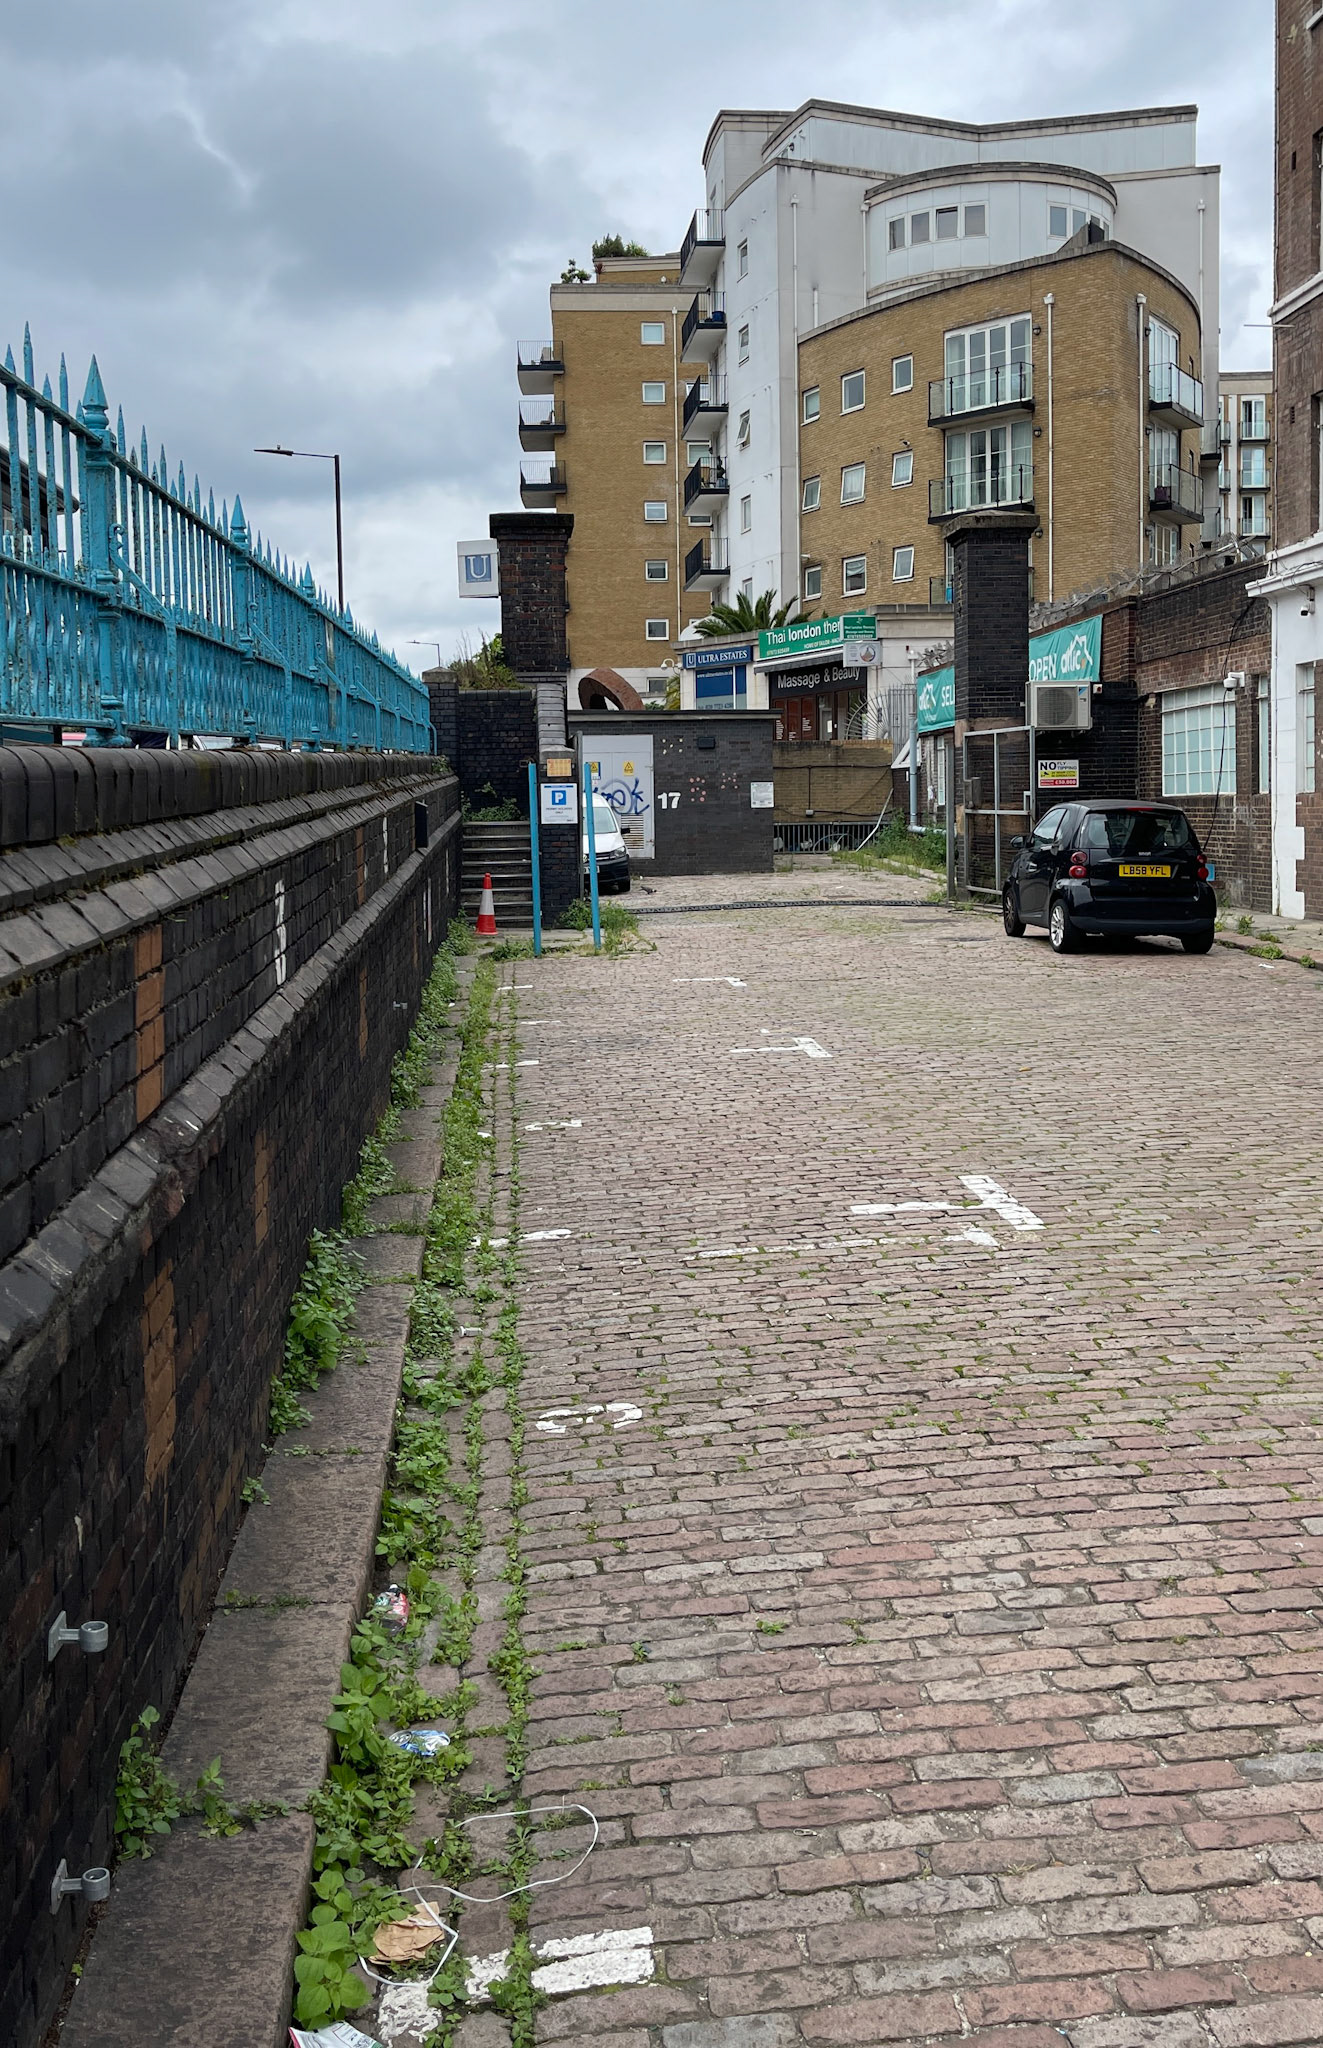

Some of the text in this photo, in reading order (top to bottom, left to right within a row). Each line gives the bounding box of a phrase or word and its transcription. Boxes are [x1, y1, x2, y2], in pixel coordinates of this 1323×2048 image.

[467, 555, 489, 579] U
[766, 630, 786, 645] Thai
[788, 624, 820, 642] london
[688, 655, 694, 664] U
[697, 650, 748, 664] ULTRA ESTATES
[1029, 636, 1085, 681] OPEN attic
[777, 666, 860, 688] Massage & Beauty
[1040, 761, 1057, 771] NO
[554, 792, 564, 804] P
[657, 791, 682, 809] 17
[1122, 866, 1167, 875] LB58 YFL
